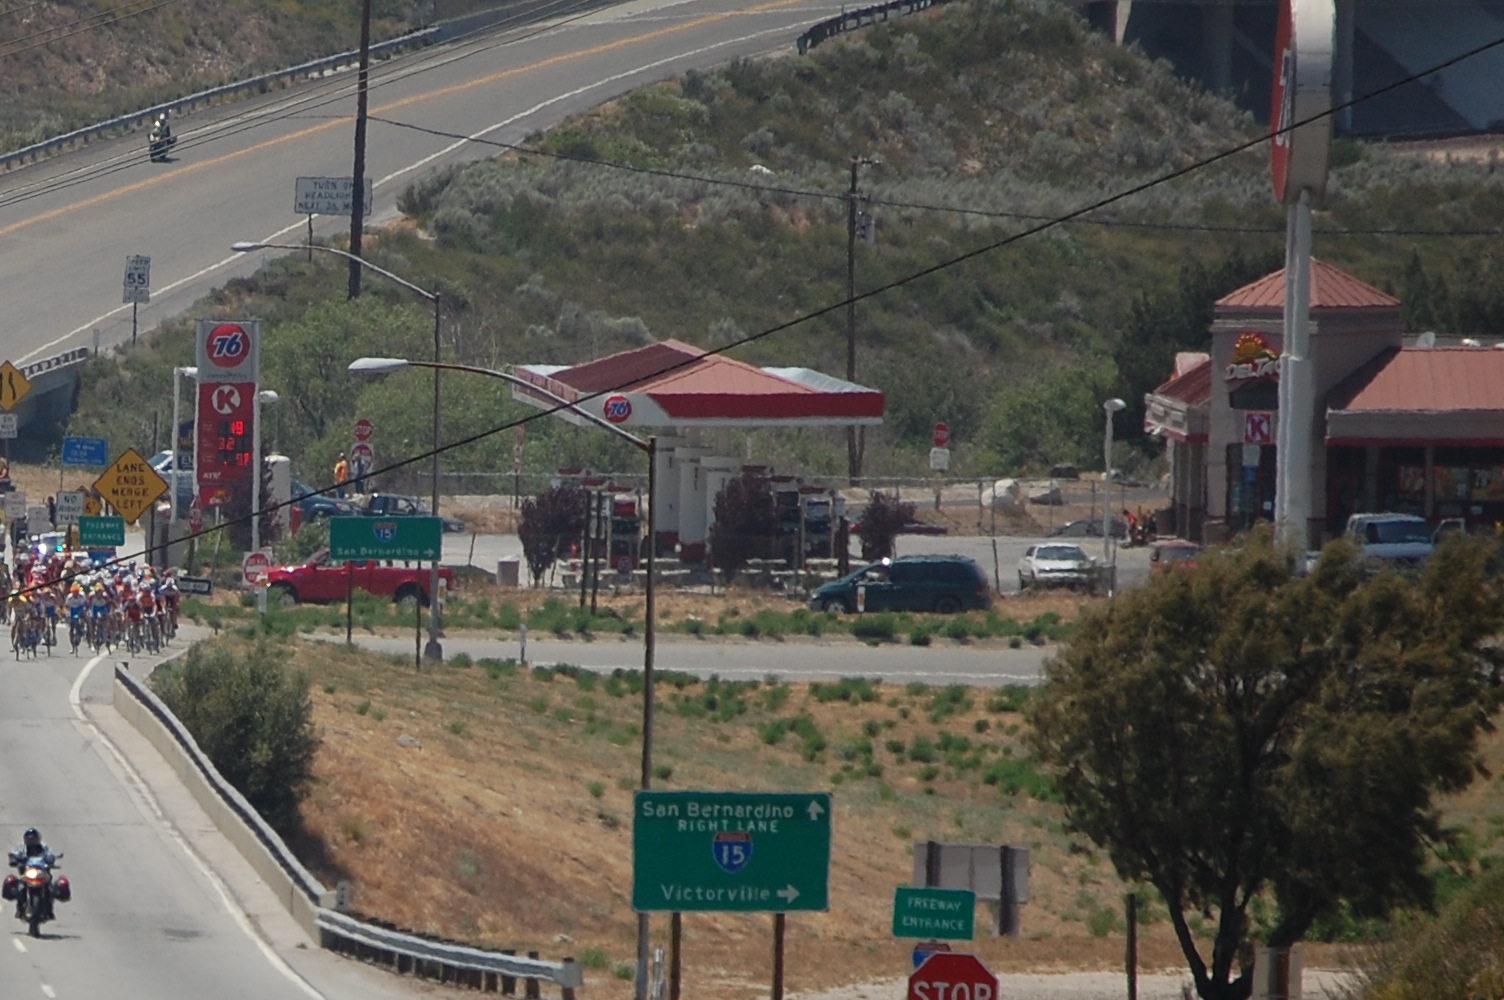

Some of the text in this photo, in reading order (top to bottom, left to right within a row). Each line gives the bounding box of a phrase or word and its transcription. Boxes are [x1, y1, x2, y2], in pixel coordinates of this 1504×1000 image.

[213, 332, 243, 358] 76
[217, 389, 236, 412] K
[607, 400, 629, 418] 76
[116, 463, 145, 473] LANE
[116, 475, 145, 486] ENDS
[64, 495, 77, 503] NO
[111, 487, 149, 498] MERGE
[116, 499, 144, 510] LEFT
[380, 528, 392, 539] 15
[337, 546, 419, 557] San Bernardino
[643, 801, 794, 819] San Bernardino
[678, 819, 779, 833] RIGHT LANE
[722, 844, 745, 866] 15
[661, 884, 771, 901] Victorville
[907, 896, 963, 913] FREEWAY
[901, 915, 966, 931] ENTRANCE
